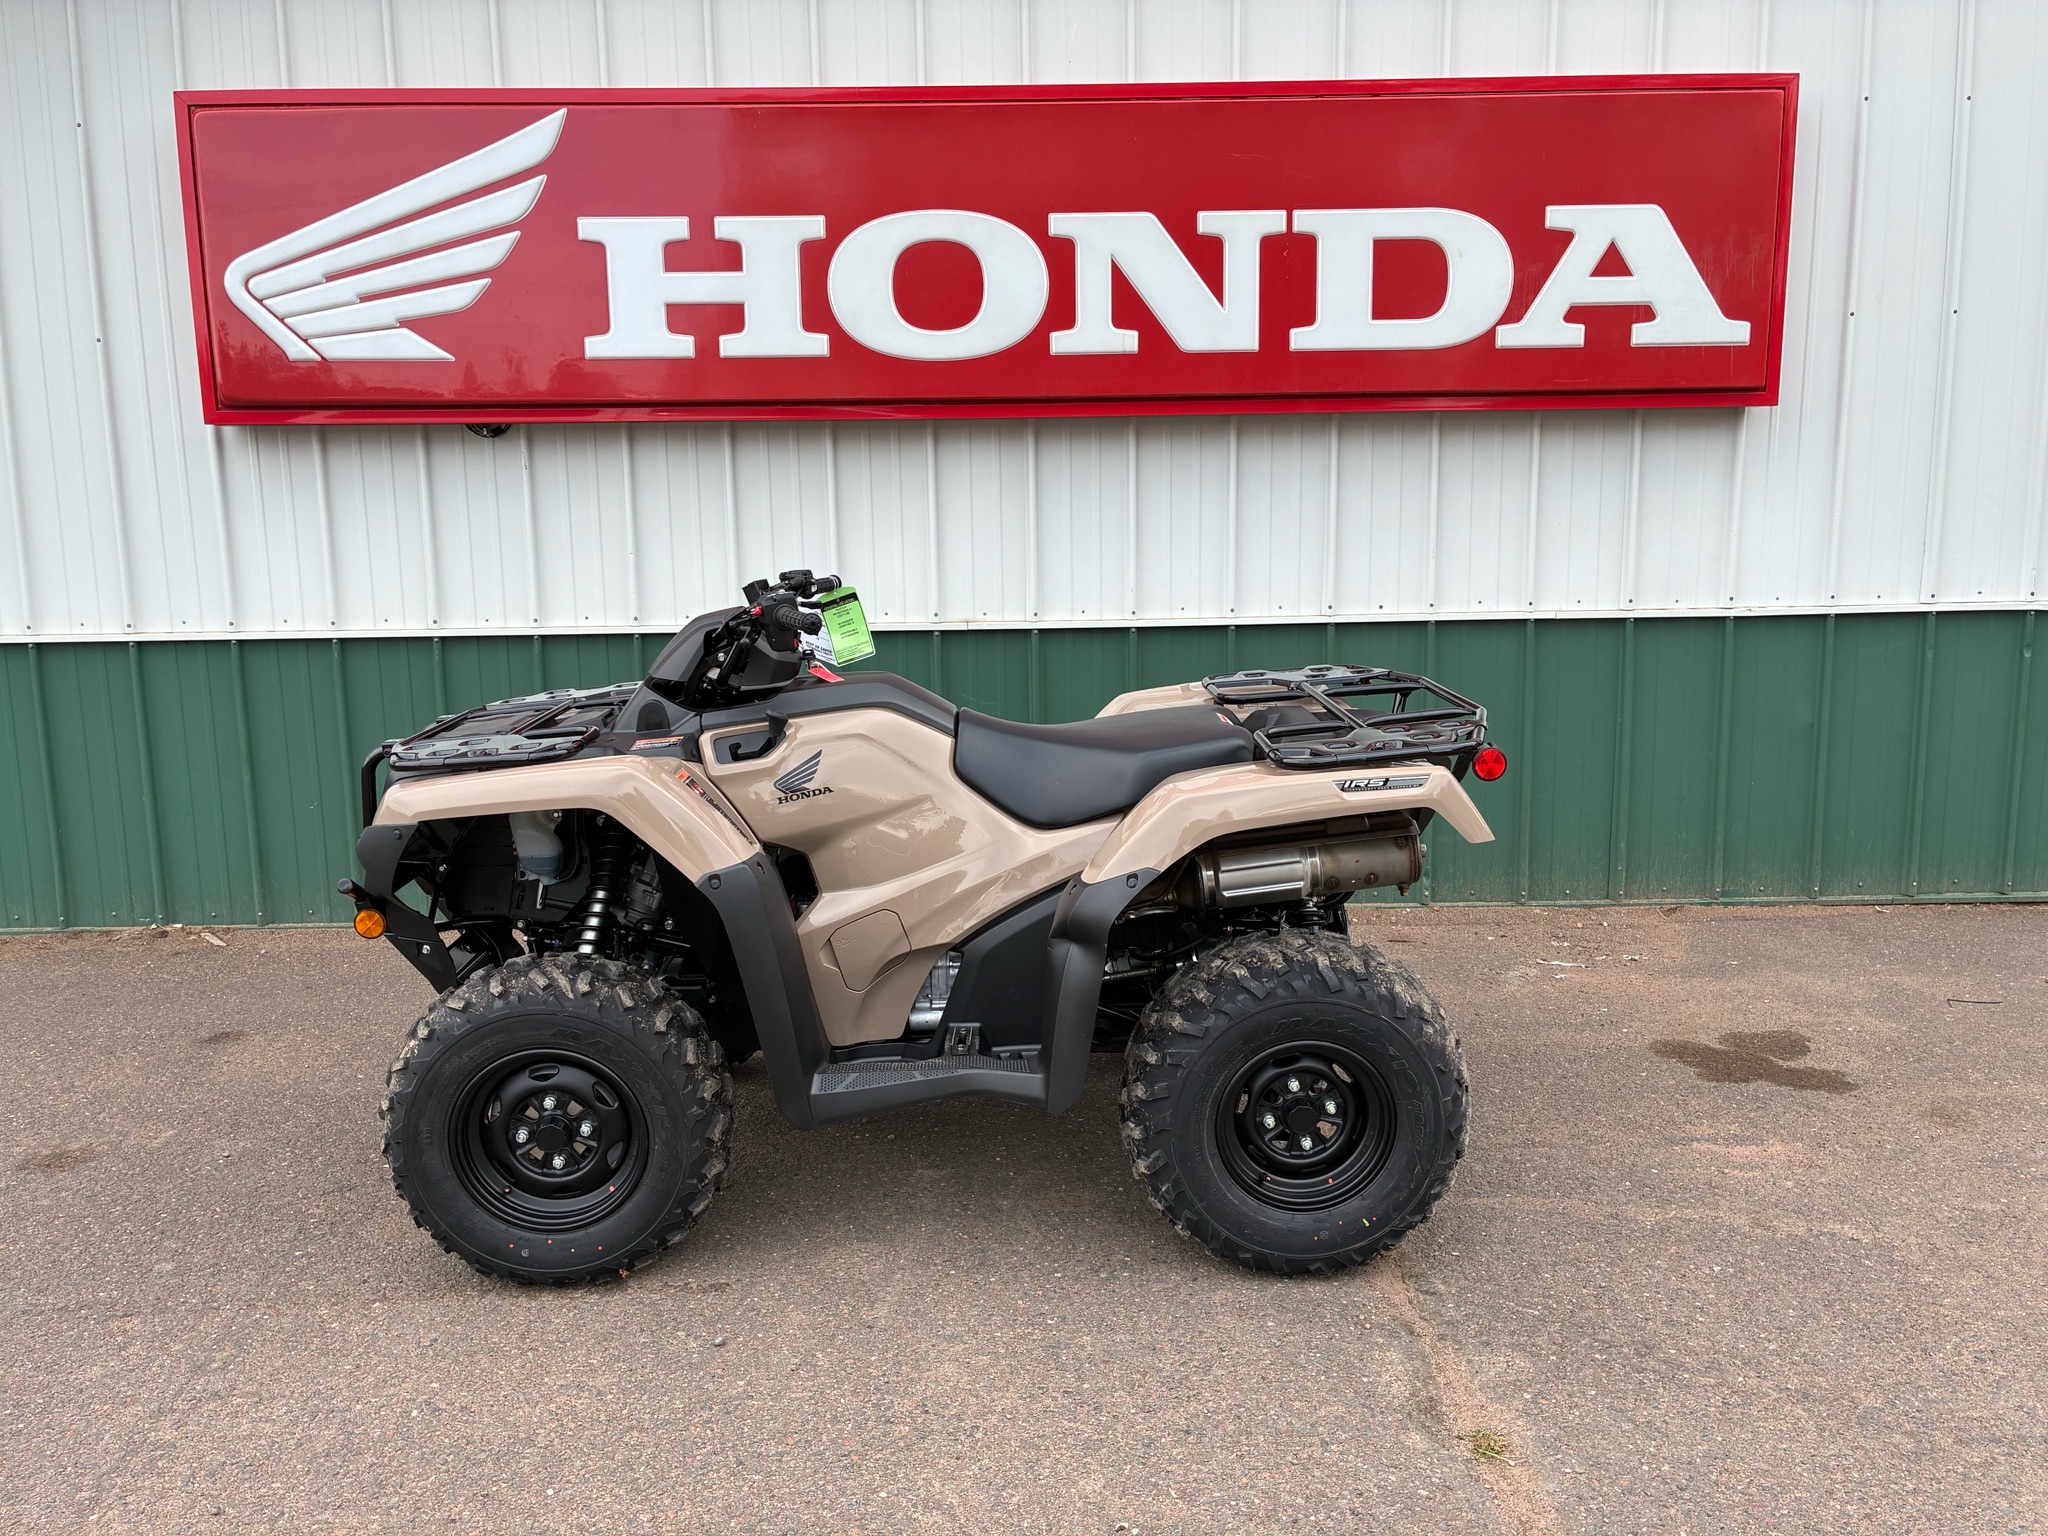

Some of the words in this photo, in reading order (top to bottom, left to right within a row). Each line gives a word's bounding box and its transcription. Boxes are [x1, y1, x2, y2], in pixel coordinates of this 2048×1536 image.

[576, 203, 1751, 362] HONDA
[1343, 778, 1387, 788] IRS
[777, 786, 834, 805] HONDA
